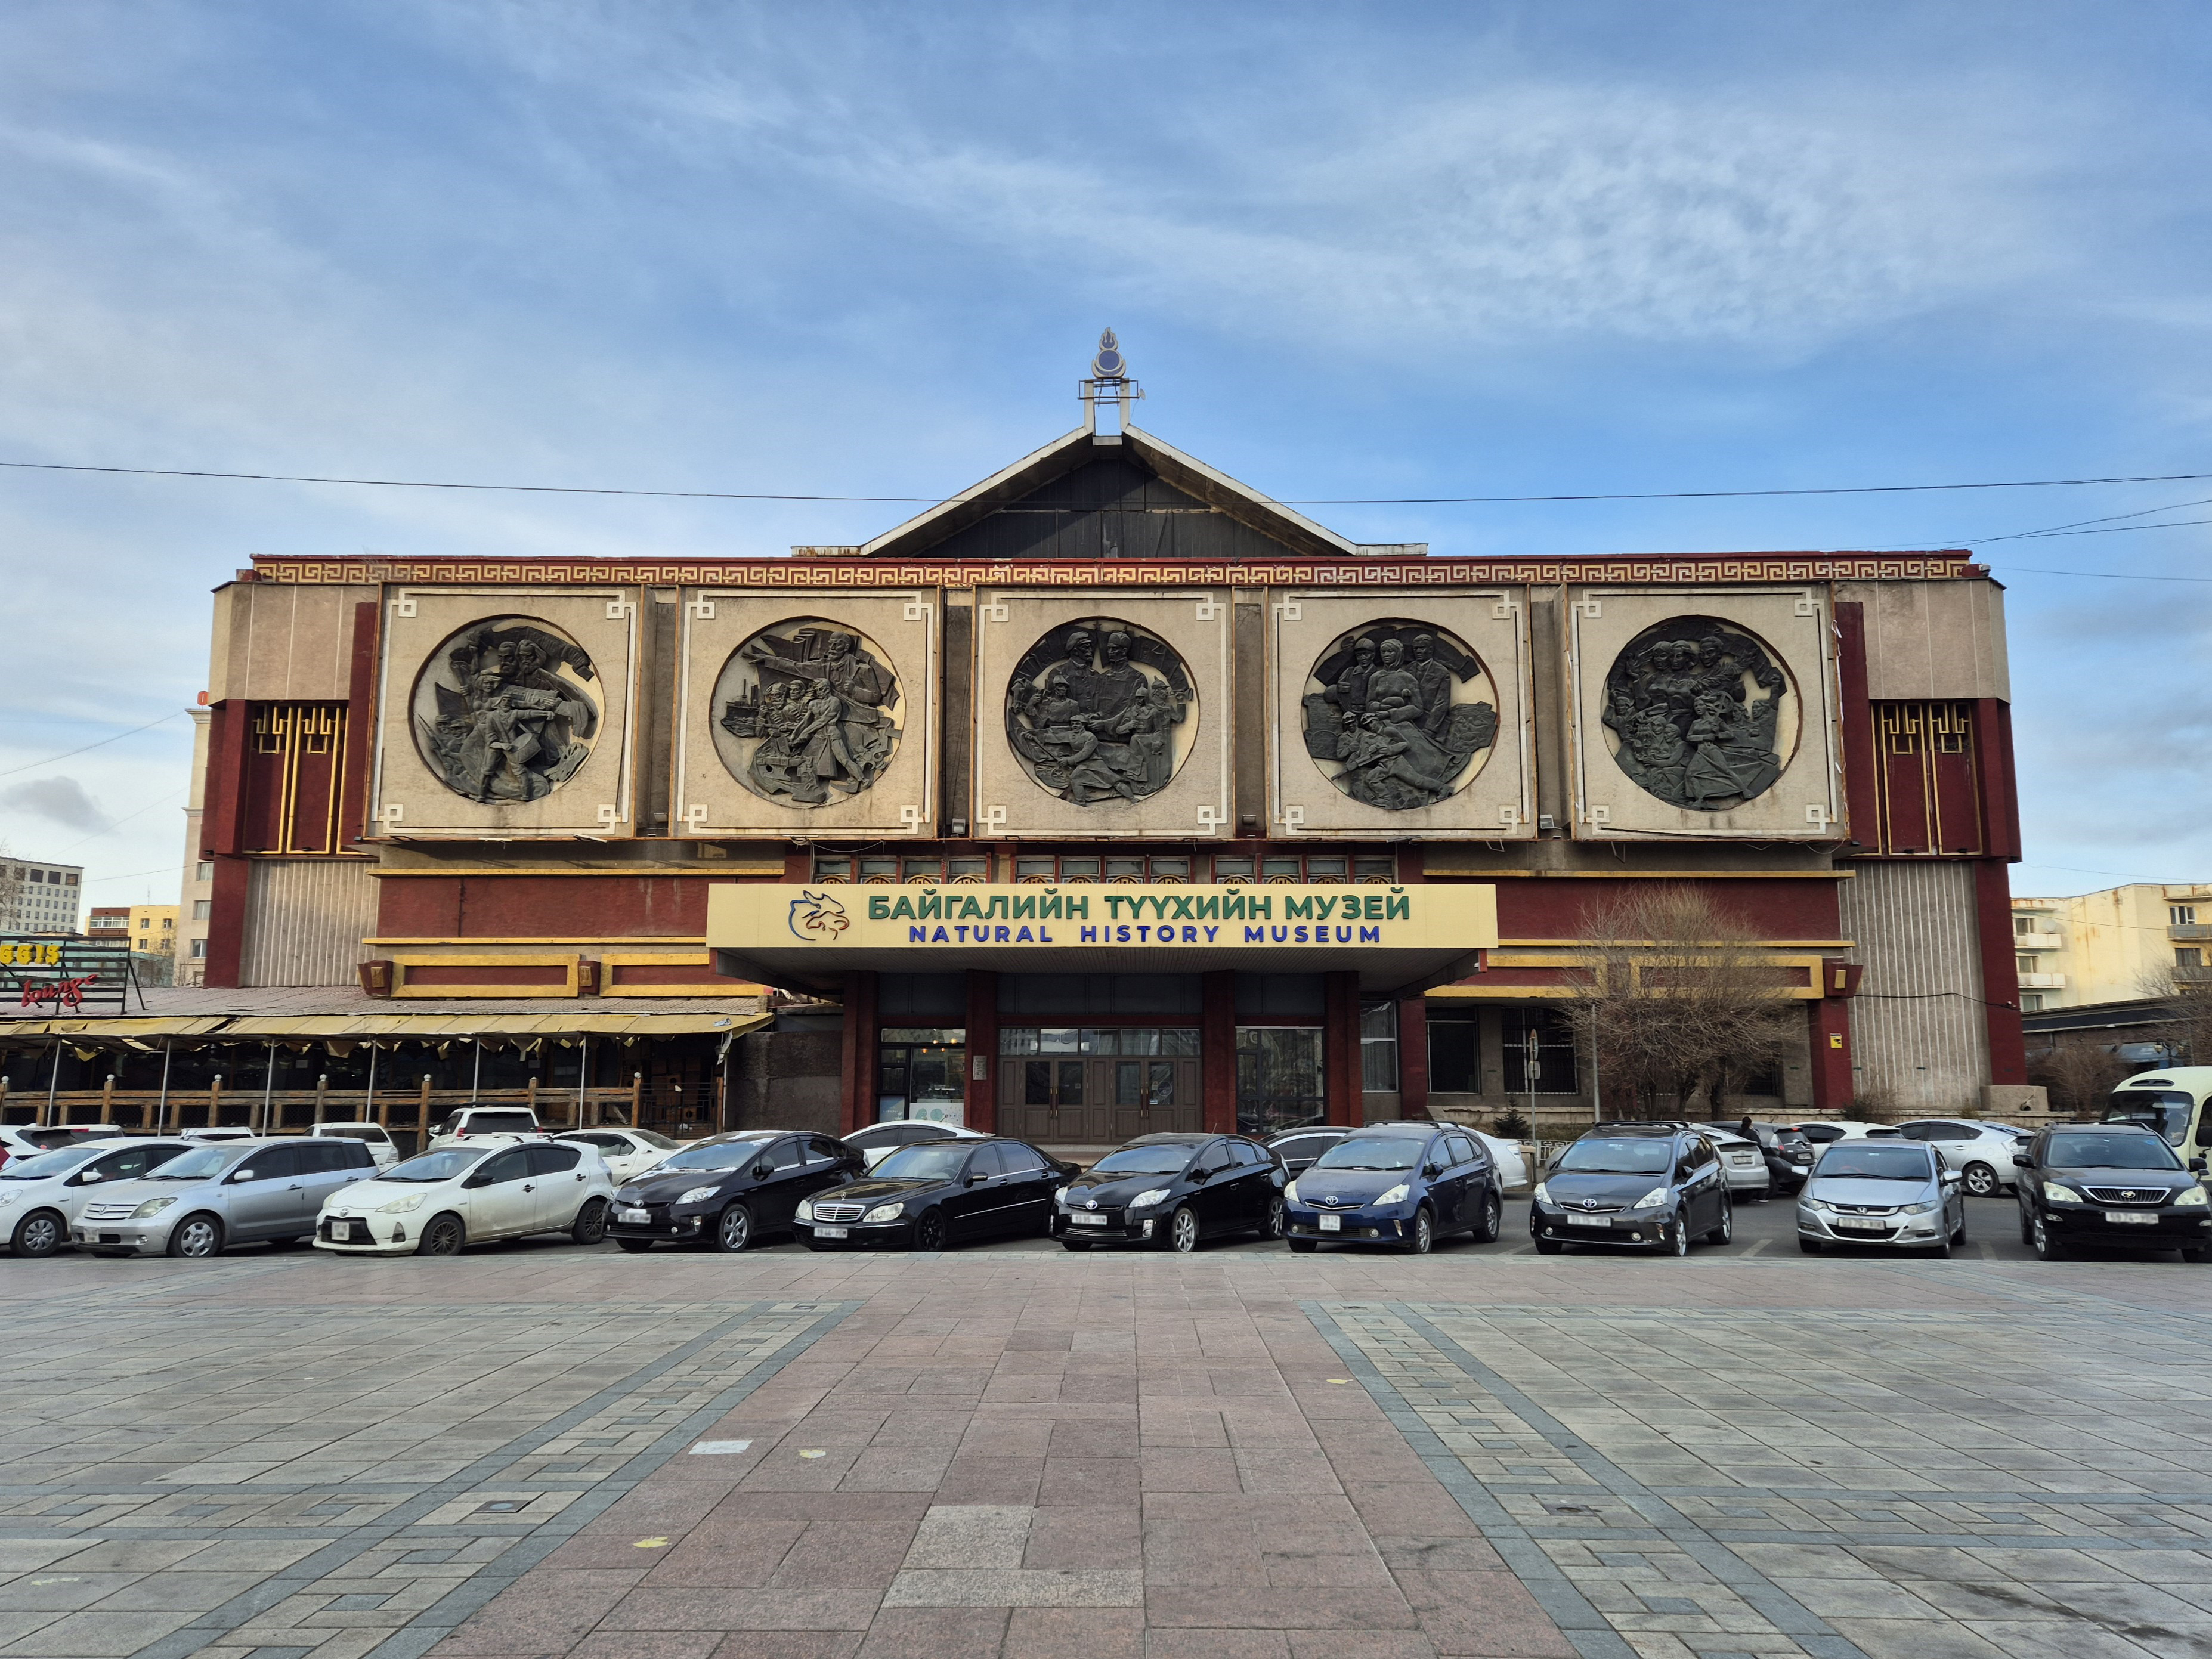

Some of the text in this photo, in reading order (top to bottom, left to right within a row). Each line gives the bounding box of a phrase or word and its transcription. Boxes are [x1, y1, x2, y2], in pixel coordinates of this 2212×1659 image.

[868, 886, 1410, 919] БАЙГАЛИЙН ТҮҮХИЙН МУЗЕЙ
[909, 925, 1380, 943] NATURAL HISTORY MUSEUM
